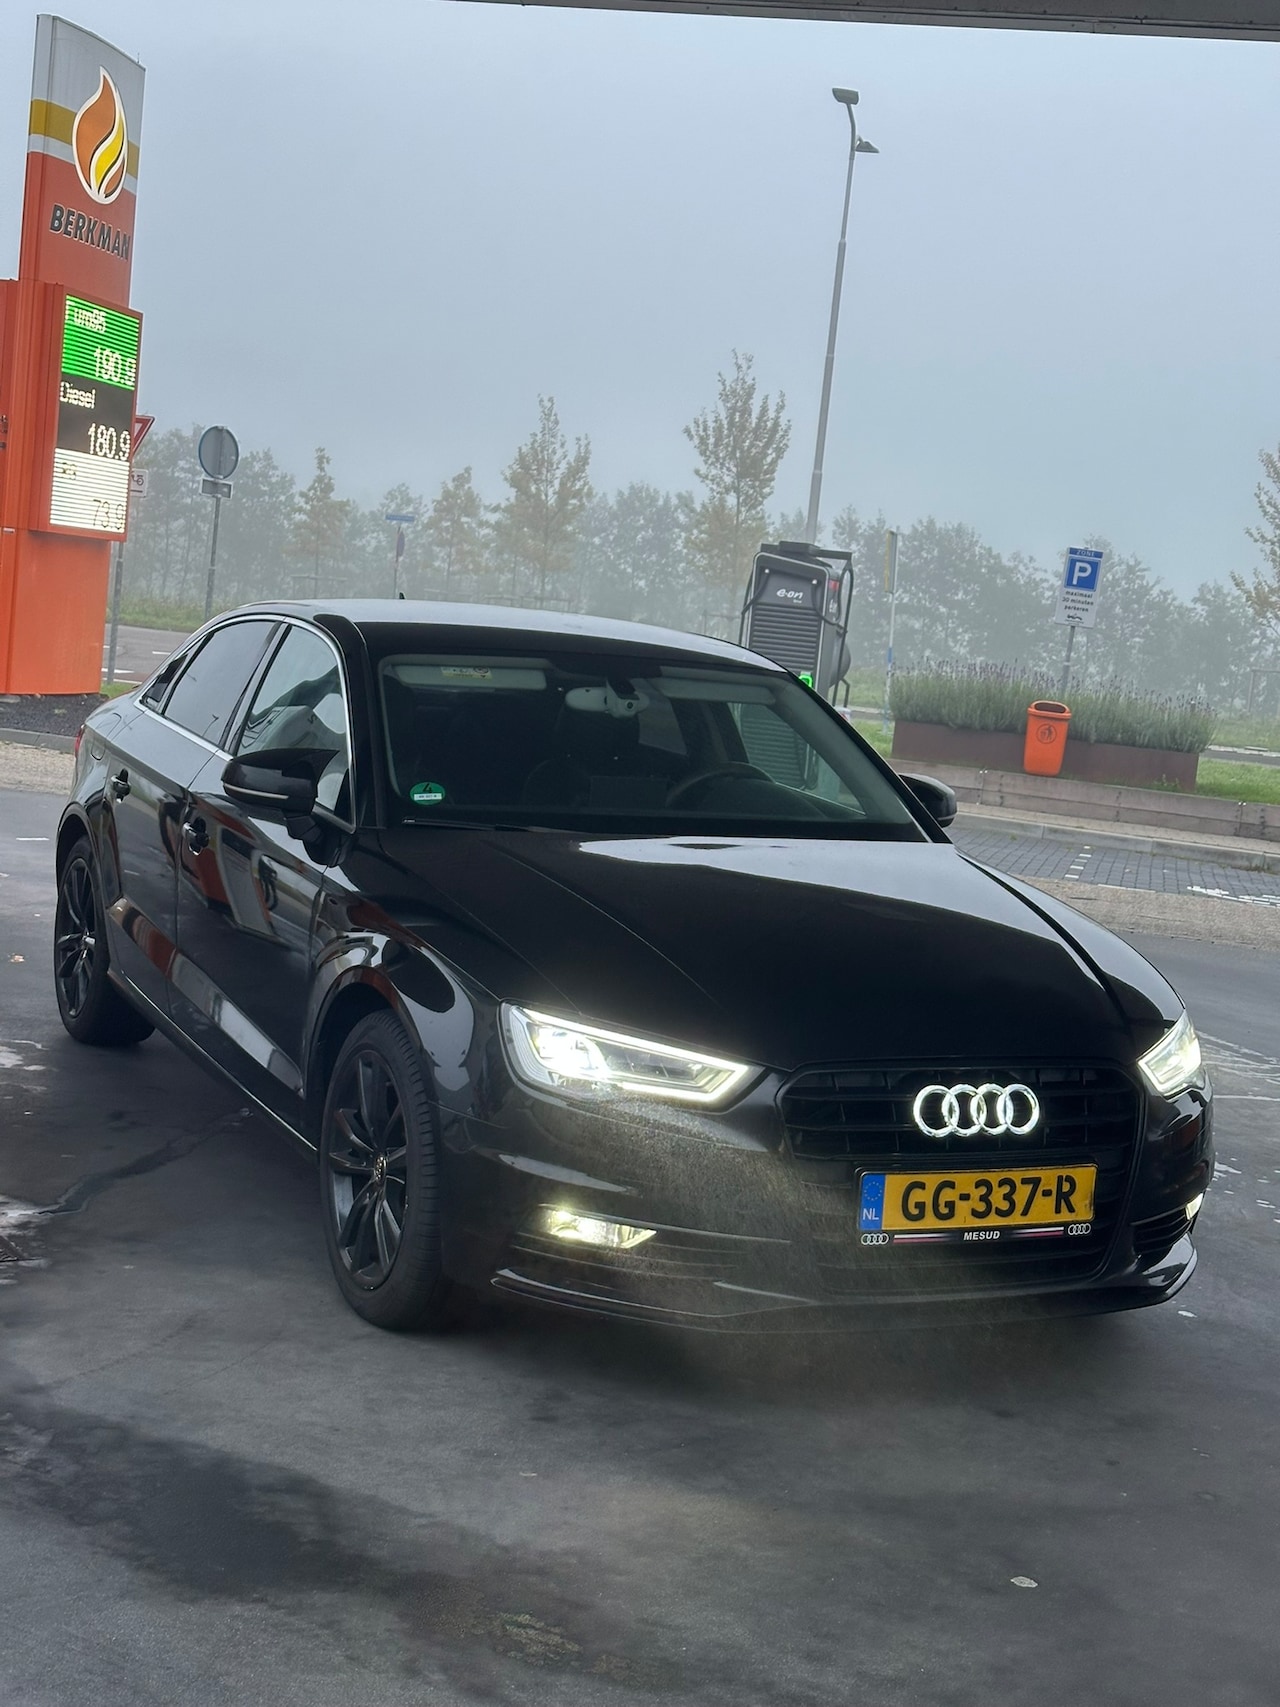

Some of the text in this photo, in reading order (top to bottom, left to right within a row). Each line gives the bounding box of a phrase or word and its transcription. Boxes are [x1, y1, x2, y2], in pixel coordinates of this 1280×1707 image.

[50, 203, 131, 261] BERKMAN
[94, 346, 137, 386] 190.9
[59, 381, 97, 409] Diesel
[87, 422, 131, 461] 180.9
[93, 499, 125, 530] 73.9
[1072, 562, 1092, 585] P
[1064, 604, 1089, 612] parkeren
[1070, 598, 1094, 606] minuten
[422, 783, 433, 794] 4
[901, 1174, 1077, 1221] GG-337-R
[862, 1207, 880, 1221] NL
[963, 1230, 1001, 1241] MESUD
